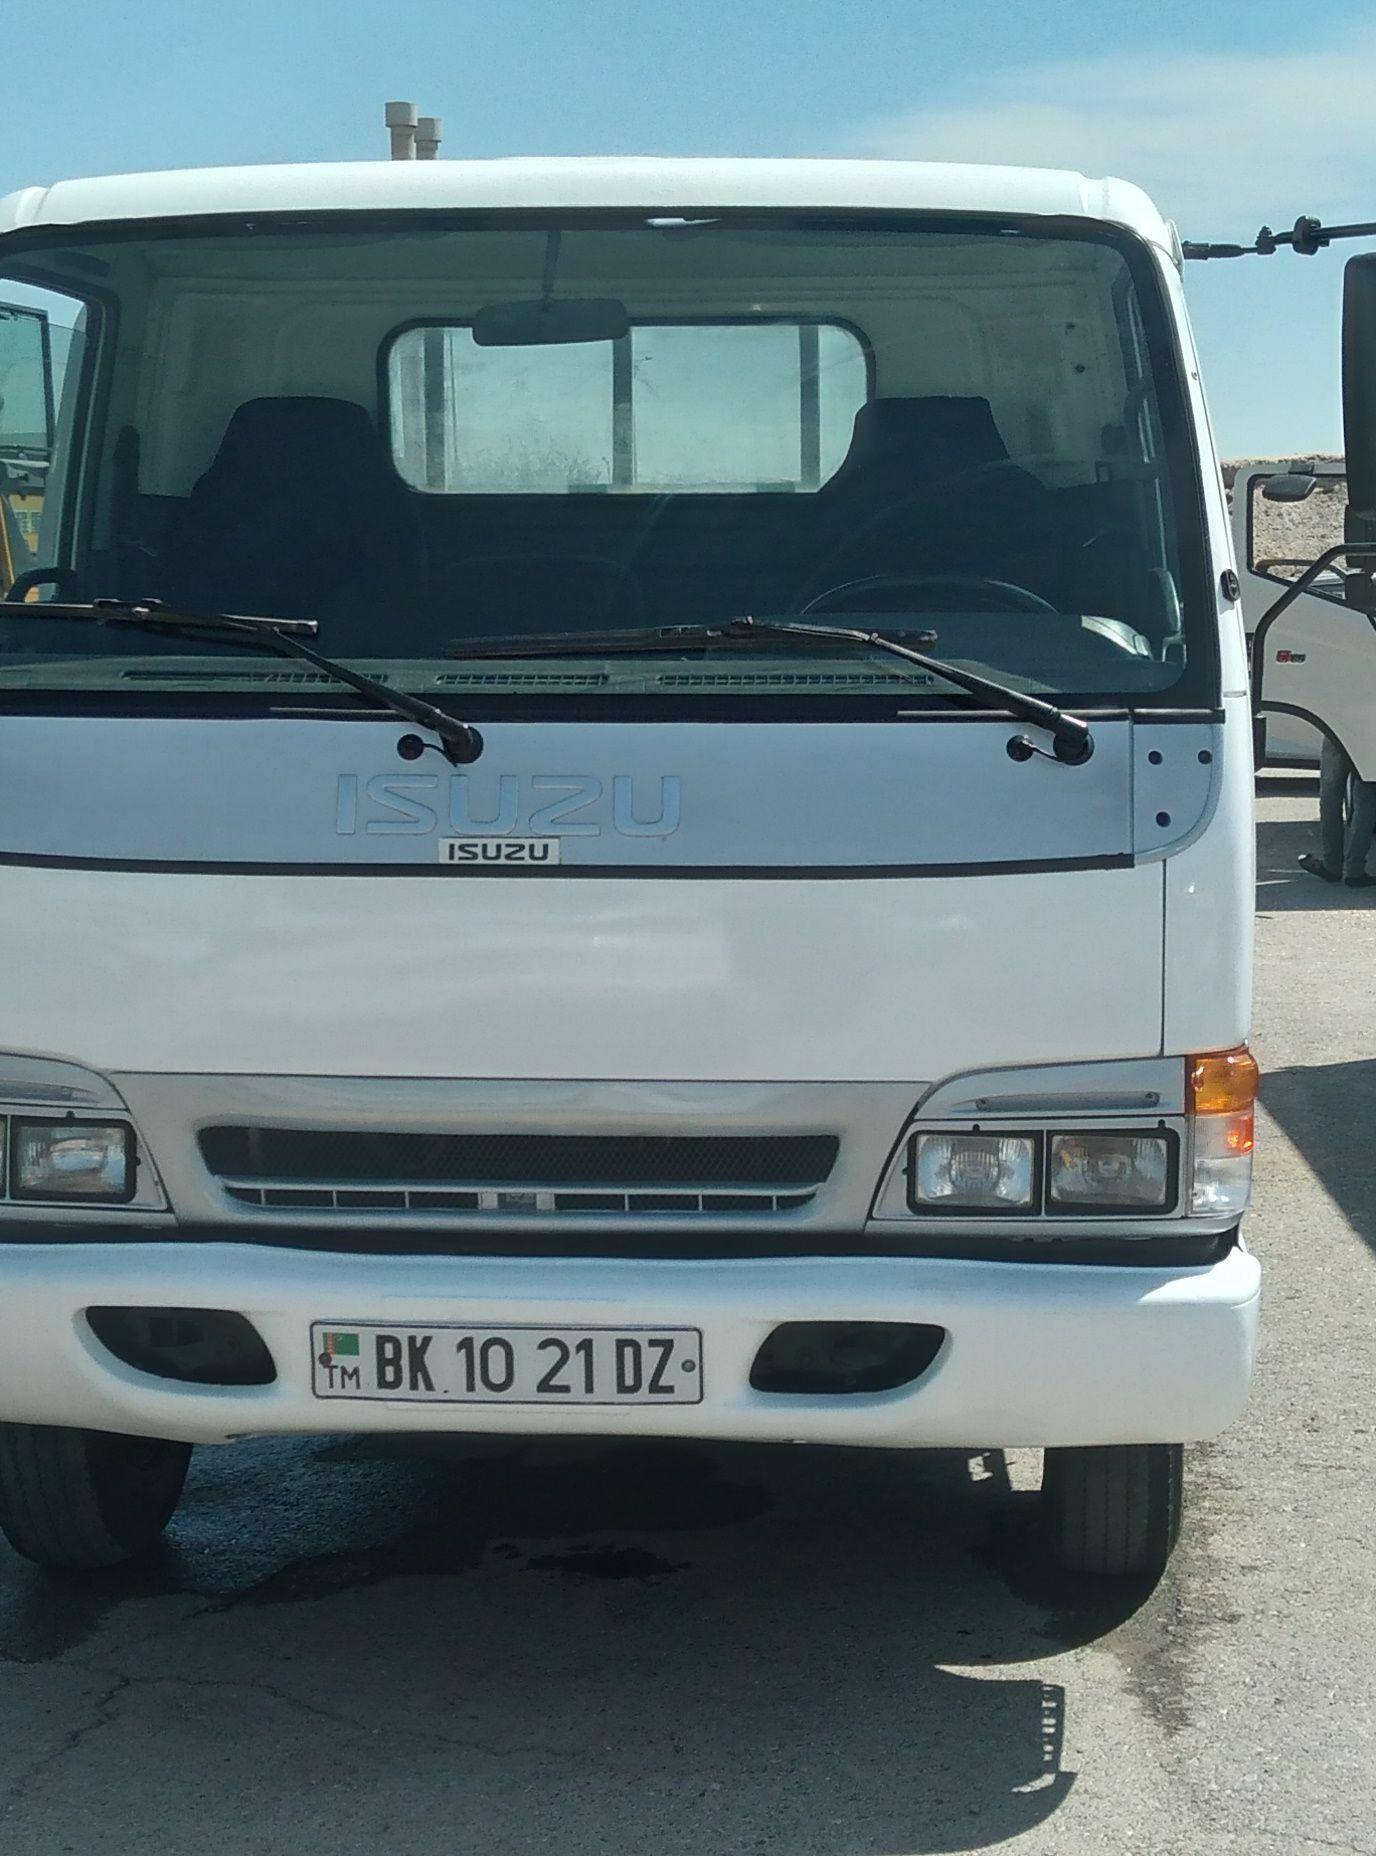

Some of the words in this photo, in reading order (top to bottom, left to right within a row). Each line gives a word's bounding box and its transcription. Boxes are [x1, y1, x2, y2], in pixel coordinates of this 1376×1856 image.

[336, 773, 681, 837] ISUZU
[448, 843, 549, 861] ISUZU
[325, 1364, 361, 1390] TM
[375, 1334, 436, 1391] BK
[456, 1336, 515, 1393] 10
[537, 1337, 595, 1394] 21
[615, 1338, 675, 1395] DZ
